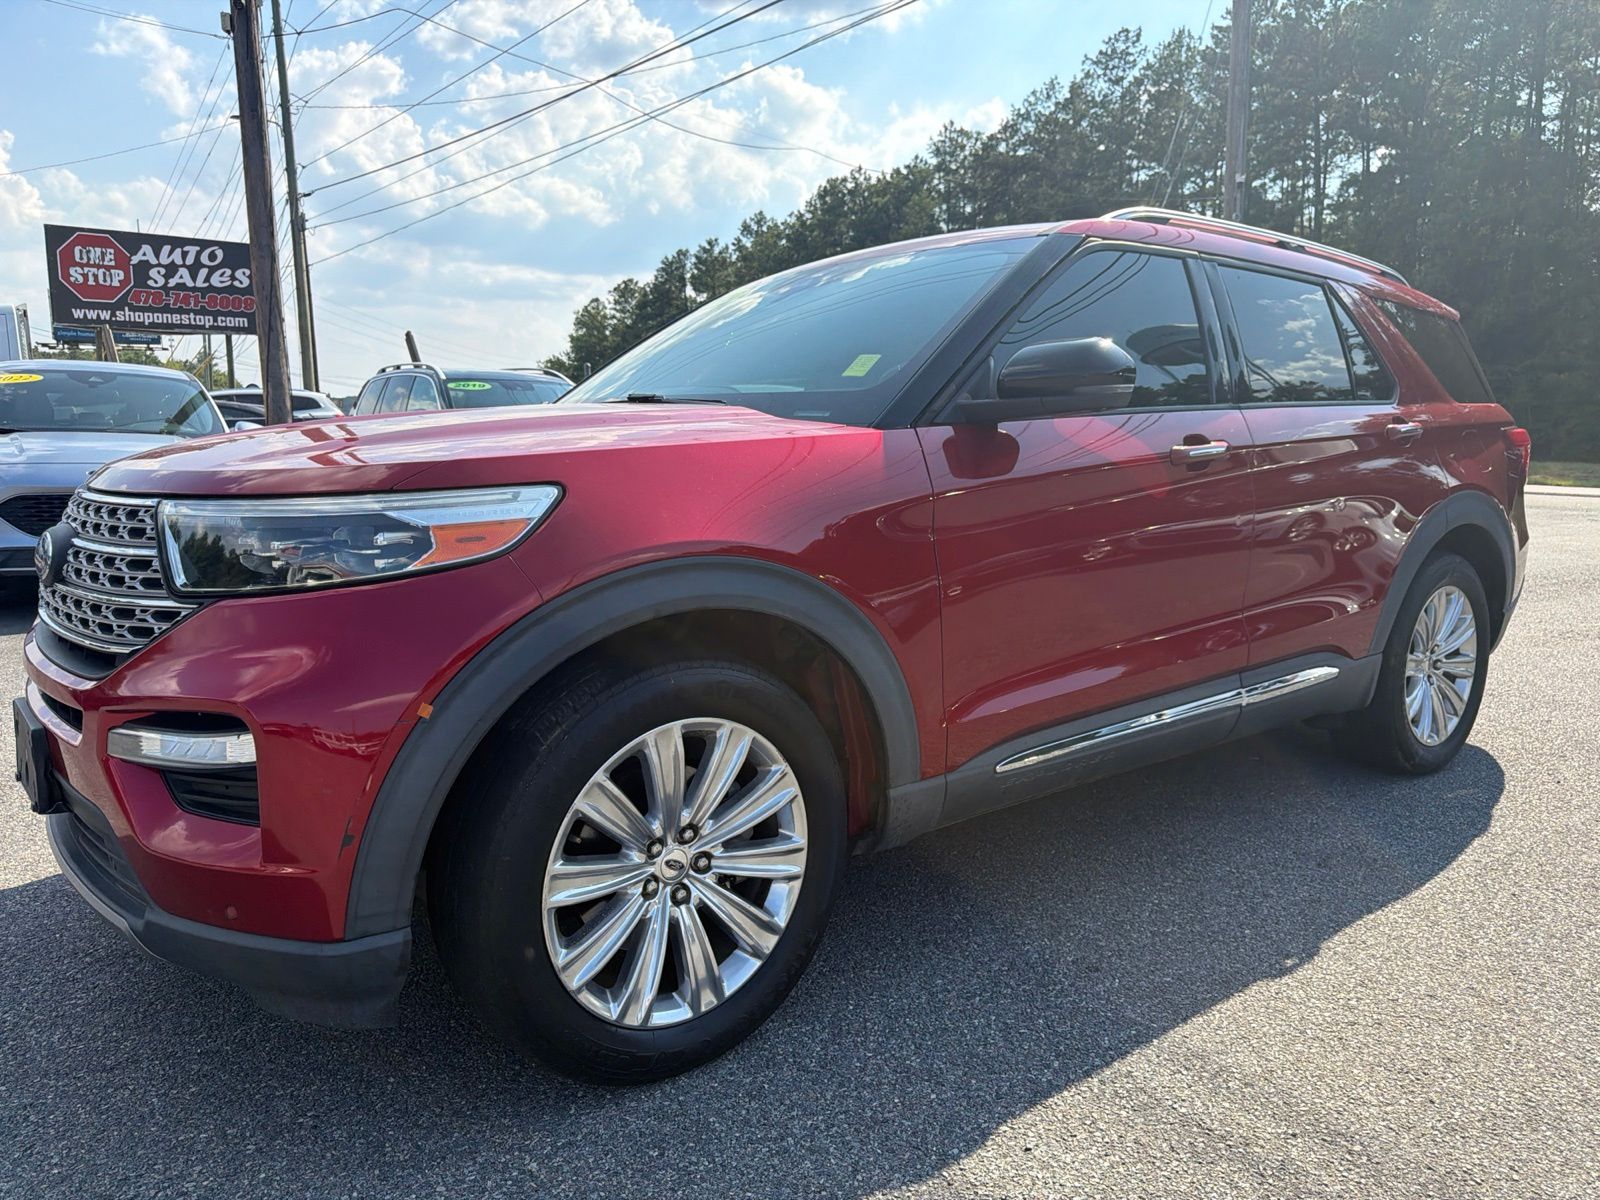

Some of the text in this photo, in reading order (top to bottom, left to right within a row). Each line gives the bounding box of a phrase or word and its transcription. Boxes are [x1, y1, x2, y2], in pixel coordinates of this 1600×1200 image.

[74, 245, 116, 267] ONE
[130, 244, 224, 267] AUTO
[69, 266, 125, 287] STOP
[71, 306, 248, 328] www.shoponestop.com
